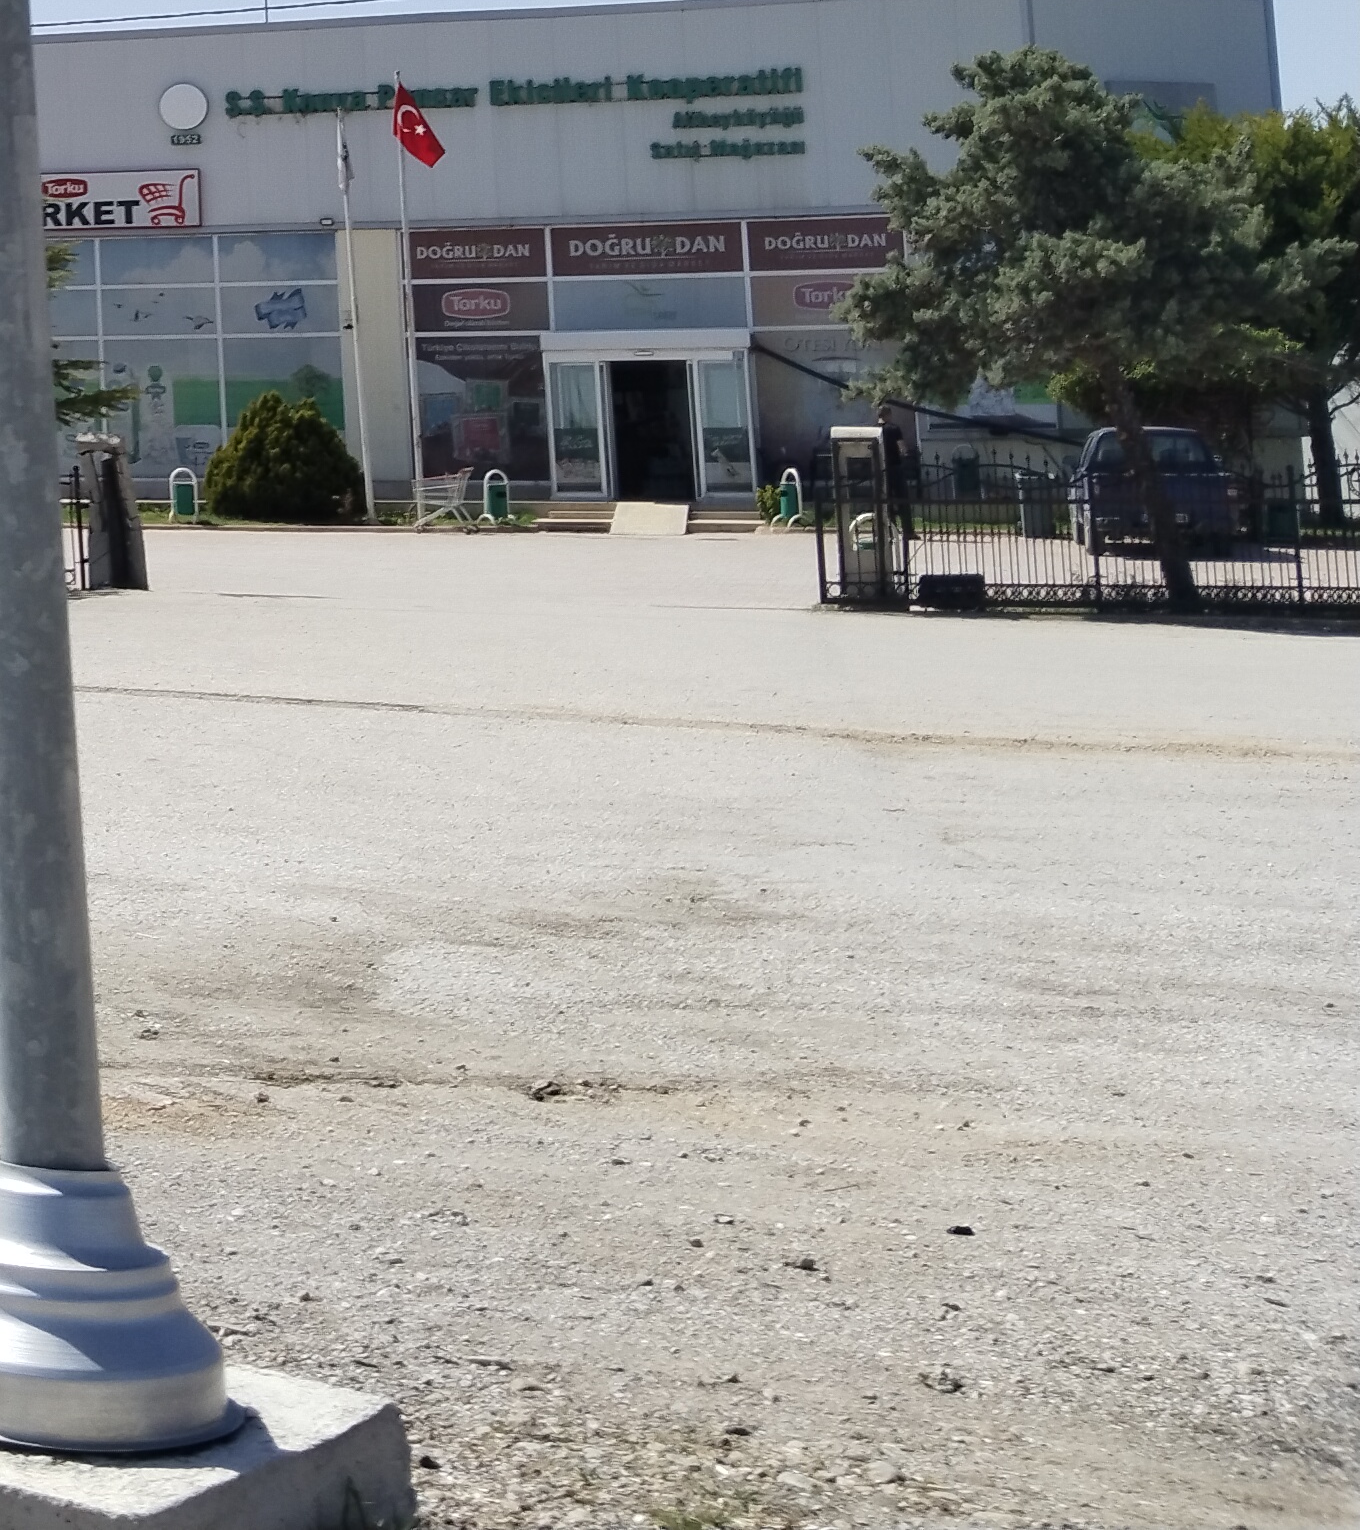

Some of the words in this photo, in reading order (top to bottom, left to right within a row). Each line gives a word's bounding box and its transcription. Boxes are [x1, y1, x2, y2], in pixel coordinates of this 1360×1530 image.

[378, 84, 478, 110] Pncar
[44, 181, 84, 195] Torku
[43, 199, 141, 227] RKET
[569, 234, 652, 257] DOĞRU
[764, 233, 828, 250] DOĞRU
[416, 242, 476, 259] DOĞRU
[800, 286, 845, 303] Tork
[449, 296, 502, 311] Torku
